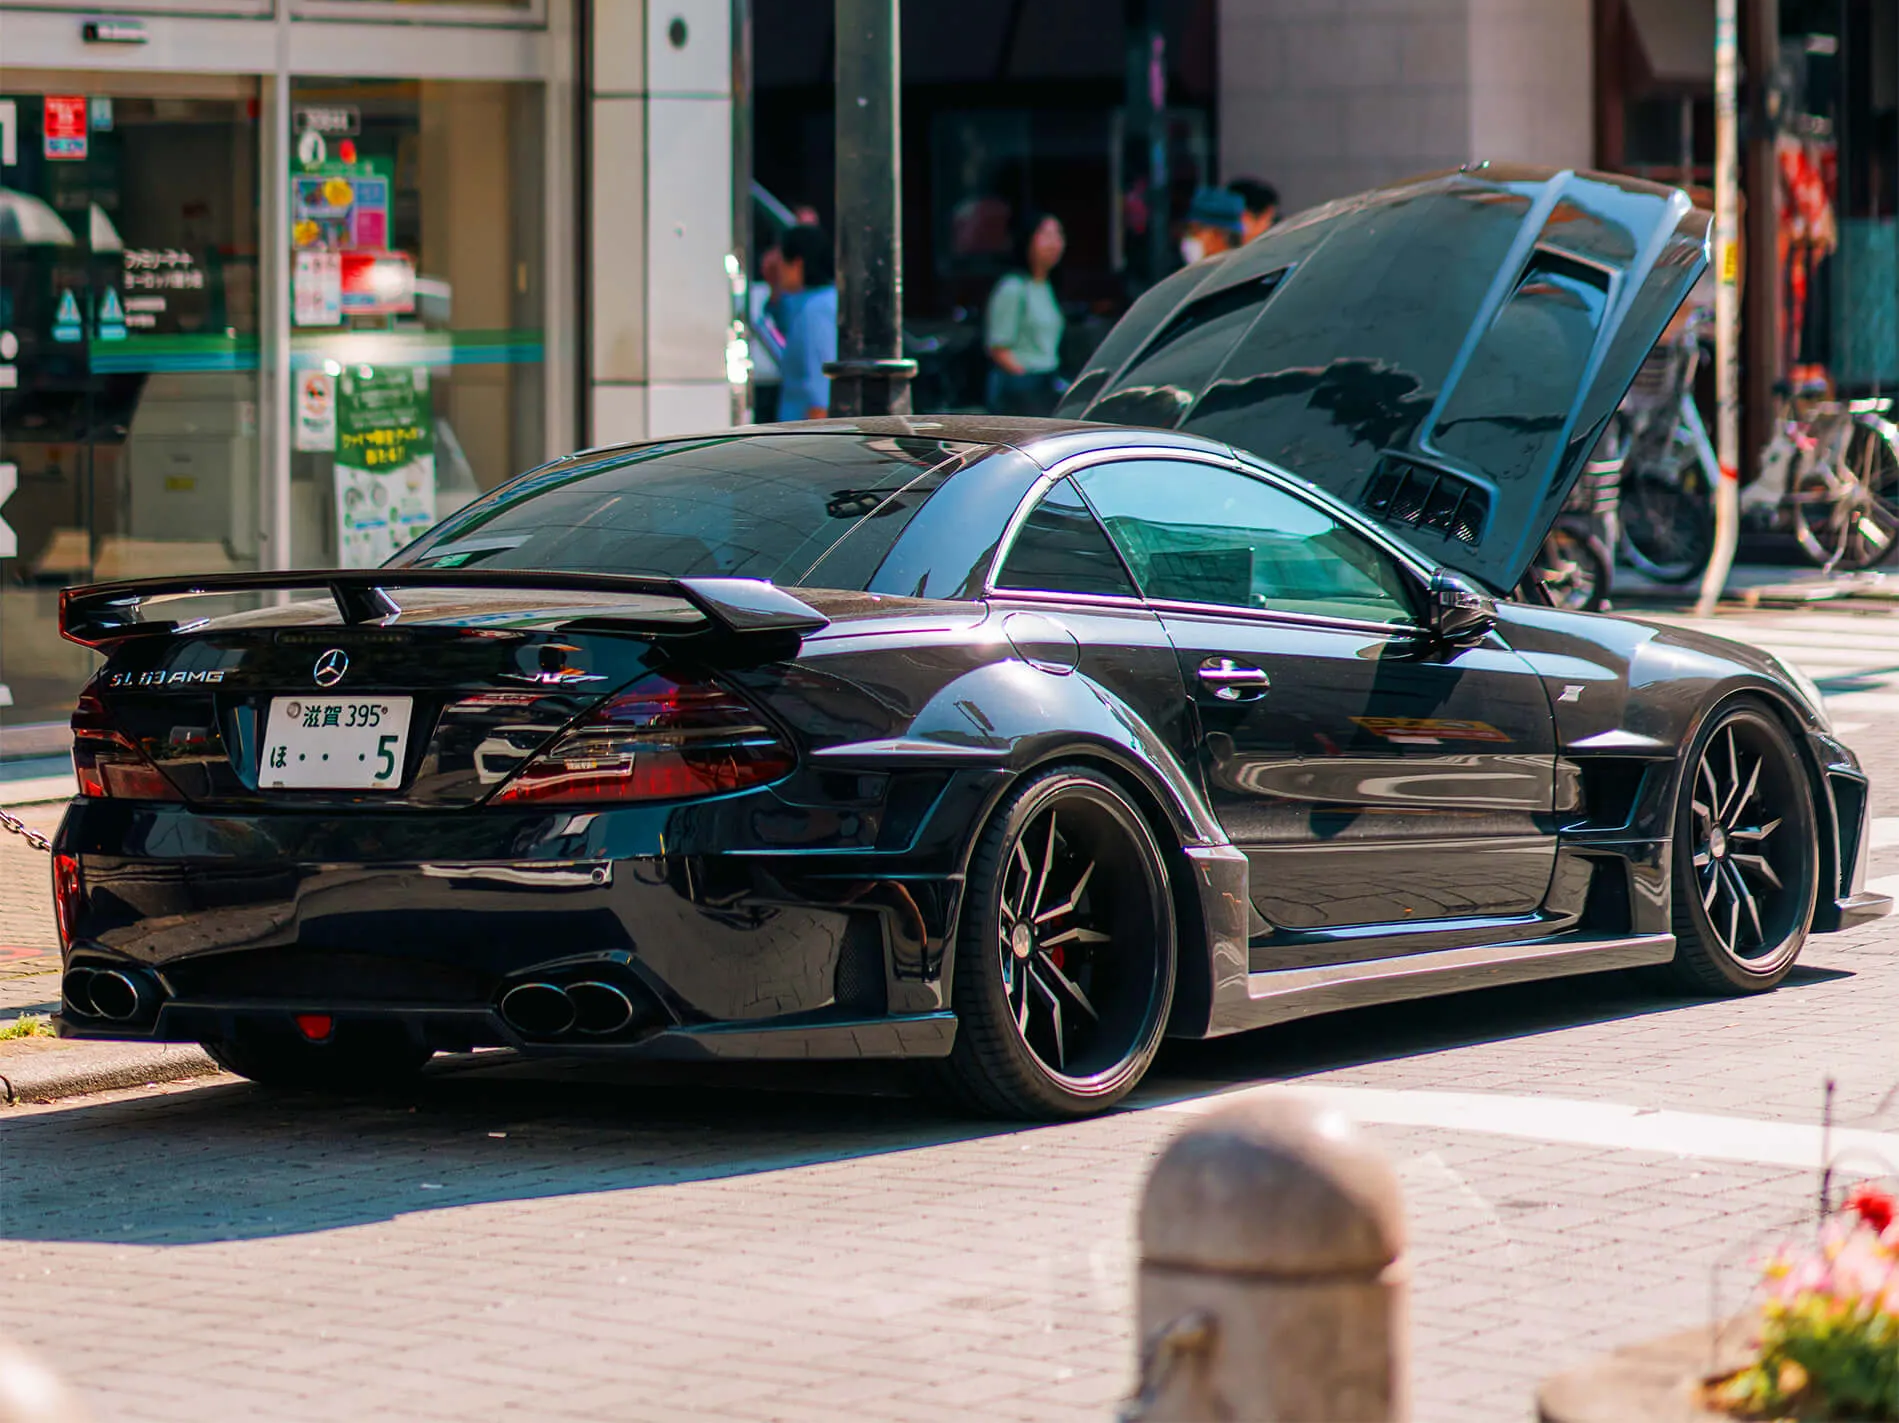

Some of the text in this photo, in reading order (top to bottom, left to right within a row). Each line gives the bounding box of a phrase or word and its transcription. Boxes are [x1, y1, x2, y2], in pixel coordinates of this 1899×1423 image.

[303, 705, 382, 727] 滋賀 395
[270, 746, 287, 768] ほ
